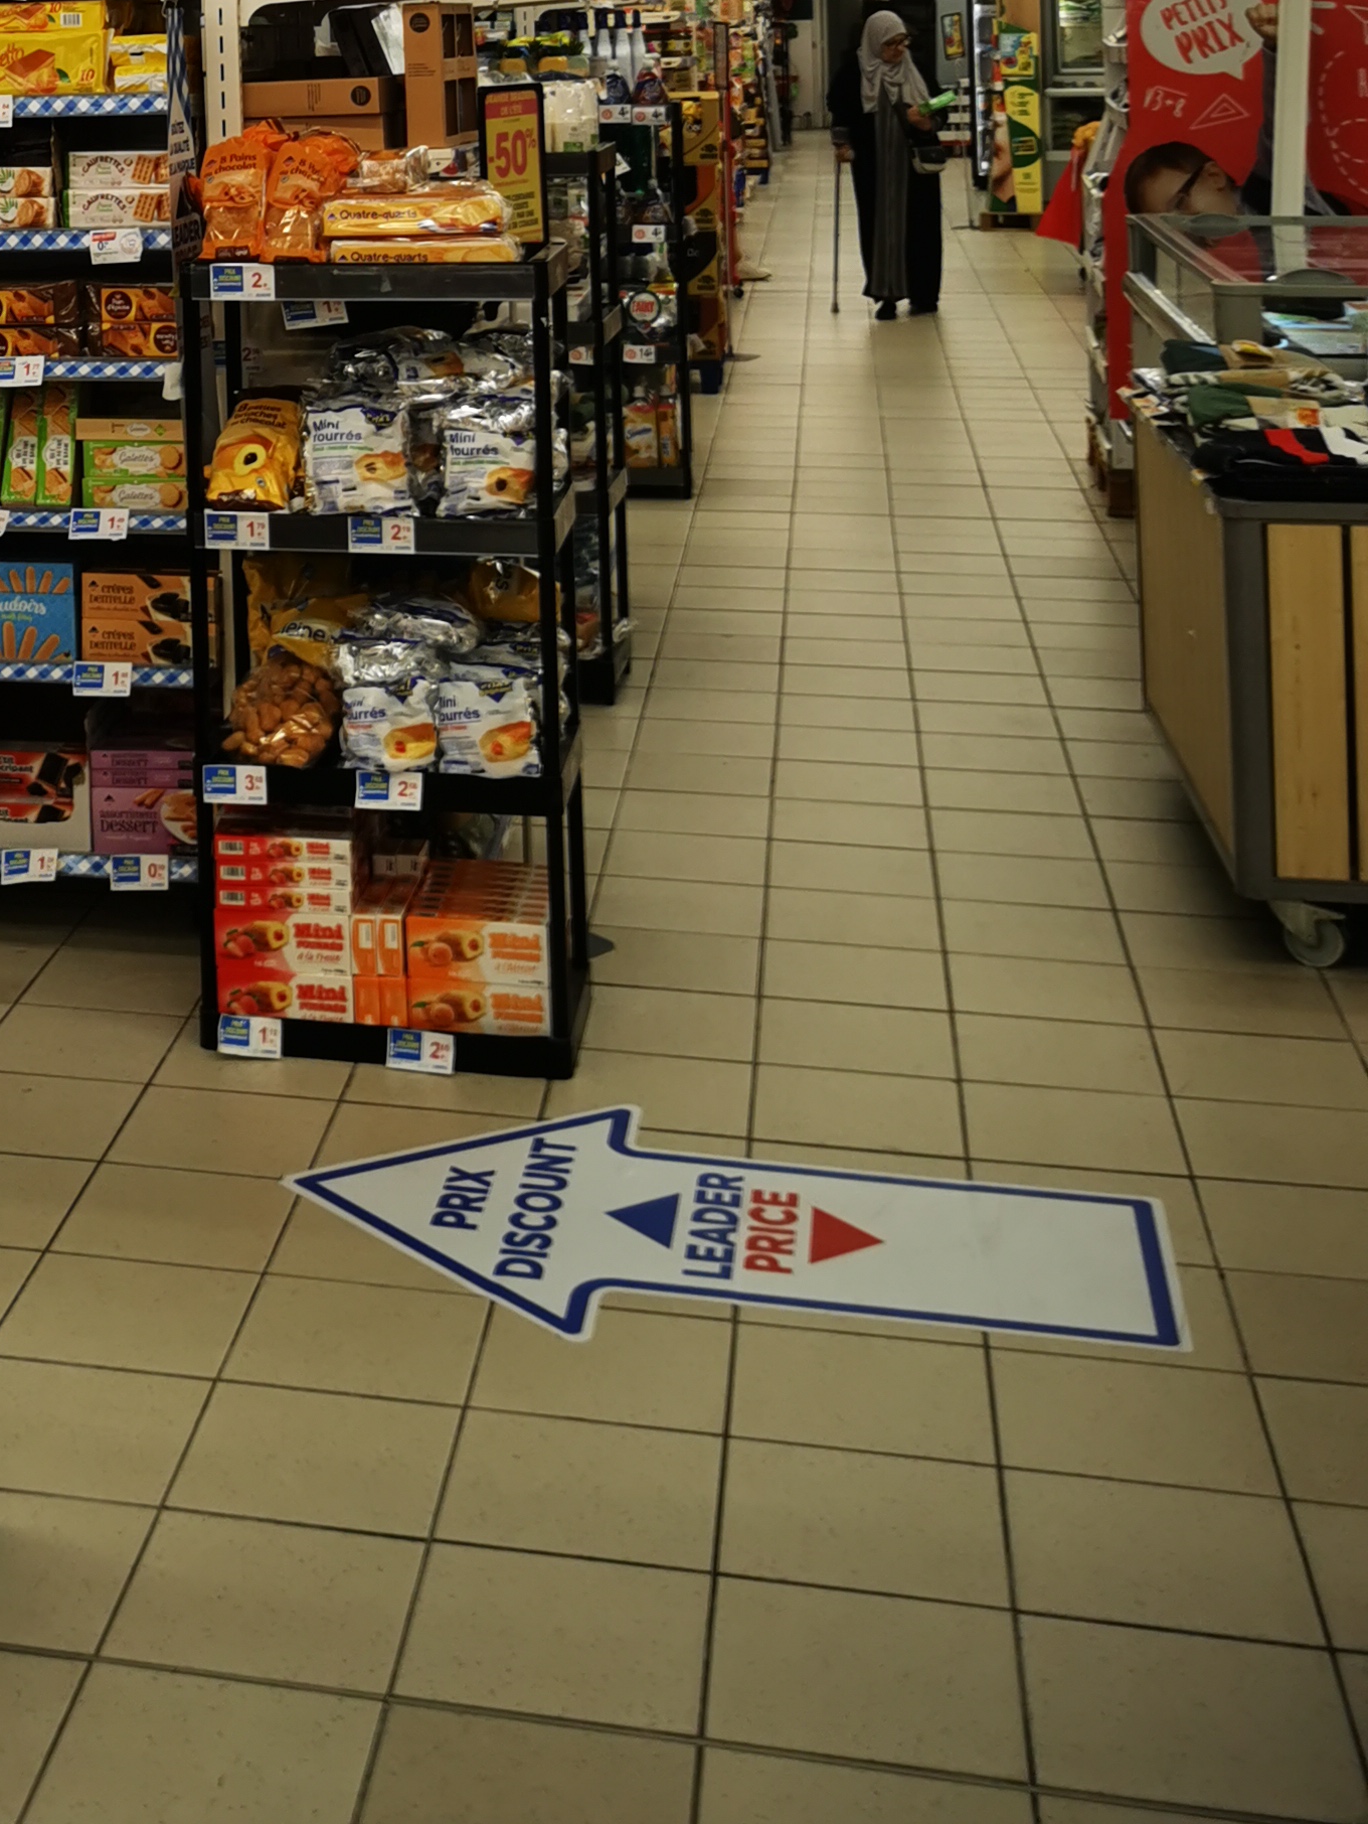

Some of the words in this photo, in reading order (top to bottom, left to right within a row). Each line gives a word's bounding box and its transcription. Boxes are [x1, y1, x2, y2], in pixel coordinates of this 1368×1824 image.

[49, 3, 62, 12] 10
[1174, 13, 1244, 64] PRIX
[229, 153, 257, 163] Pains
[214, 161, 257, 174] chocolat
[340, 209, 417, 222] Quatre-quarts
[350, 251, 428, 262] Quatre-quarts
[313, 419, 339, 432] Mini
[450, 432, 476, 444] Mini
[450, 444, 499, 456] fourrés
[118, 451, 155, 465] Galettes
[119, 489, 155, 503] Galettes
[431, 1165, 496, 1232] PRIX
[493, 1136, 579, 1281] DISCOUNT
[681, 1172, 745, 1281] LEADER
[744, 1189, 800, 1277] PRICE
